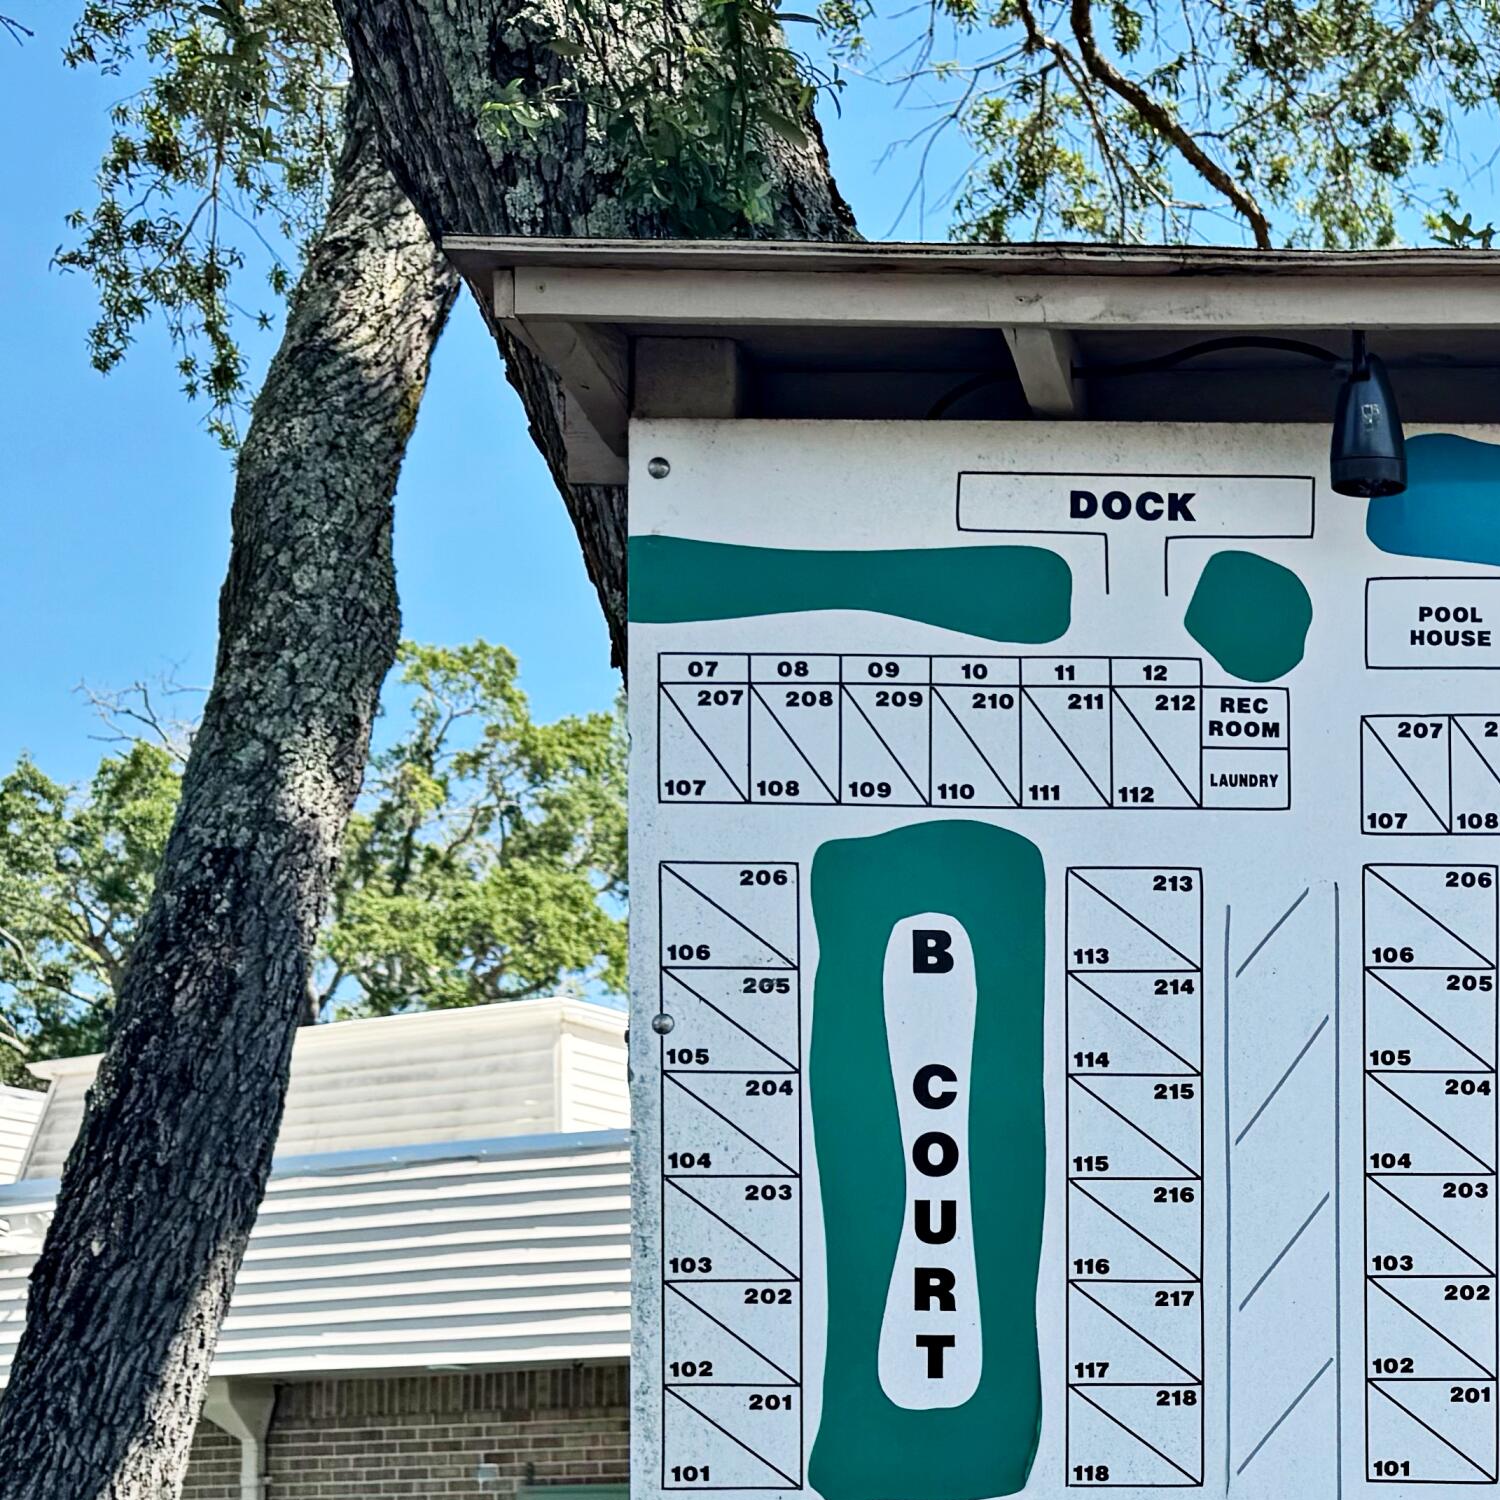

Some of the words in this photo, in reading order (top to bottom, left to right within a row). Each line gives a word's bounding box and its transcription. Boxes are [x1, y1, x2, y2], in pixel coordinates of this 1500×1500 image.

[1069, 490, 1197, 522] DOCK
[1418, 606, 1483, 623] POOL
[1410, 629, 1492, 647] HOUSE
[687, 661, 719, 678] 07
[777, 660, 809, 678] 08
[867, 661, 900, 679] 09
[961, 663, 988, 680] 10
[1054, 664, 1075, 681] 11
[1142, 664, 1168, 682] 12
[697, 689, 744, 707] 207
[785, 690, 834, 708] 208
[875, 690, 923, 708] 209
[972, 692, 1015, 710] 210
[1067, 693, 1104, 710] 211
[1155, 694, 1196, 711] 212
[1220, 697, 1269, 714] REC
[1208, 720, 1280, 738] ROOM
[1397, 721, 1443, 739] 207
[664, 779, 707, 796] 107
[756, 780, 800, 797] 108
[1210, 773, 1279, 788] LAUNDRY
[848, 781, 892, 799] 109
[937, 783, 975, 800] 110
[1028, 784, 1060, 801] 111
[1118, 786, 1155, 803] 112
[1367, 812, 1408, 830] 107
[1456, 812, 1499, 830] 108
[739, 869, 788, 886] 206
[1152, 874, 1193, 893] 213
[1445, 871, 1492, 889] 206
[666, 944, 711, 961] 106
[912, 929, 955, 974] B
[1073, 947, 1110, 965] 113
[1371, 946, 1415, 964] 106
[742, 977, 791, 995] 205
[1154, 978, 1195, 996] 214
[1446, 974, 1493, 992] 205
[666, 1048, 710, 1066] 105
[1073, 1051, 1110, 1068] 114
[1369, 1049, 1412, 1066] 105
[745, 1079, 794, 1097] 204
[1153, 1083, 1195, 1100] 215
[1444, 1078, 1492, 1096] 204
[667, 1152, 712, 1169] 104
[1072, 1155, 1109, 1172] 115
[1369, 1152, 1412, 1169] 104
[744, 1184, 793, 1201] 203
[1153, 1186, 1195, 1203] 216
[1442, 1182, 1489, 1199] 203
[912, 1063, 960, 1379] COURT
[669, 1256, 713, 1274] 103
[1073, 1258, 1110, 1275] 116
[1371, 1254, 1414, 1272] 103
[743, 1287, 792, 1305] 202
[1154, 1290, 1195, 1307] 217
[1444, 1284, 1490, 1301] 202
[669, 1360, 713, 1378] 102
[1074, 1361, 1110, 1379] 117
[1372, 1357, 1414, 1374] 102
[748, 1393, 792, 1411] 201
[1156, 1389, 1198, 1407] 218
[1450, 1386, 1491, 1404] 201
[671, 1465, 710, 1482] 101
[1072, 1465, 1110, 1482] 118
[1373, 1460, 1410, 1477] 101
